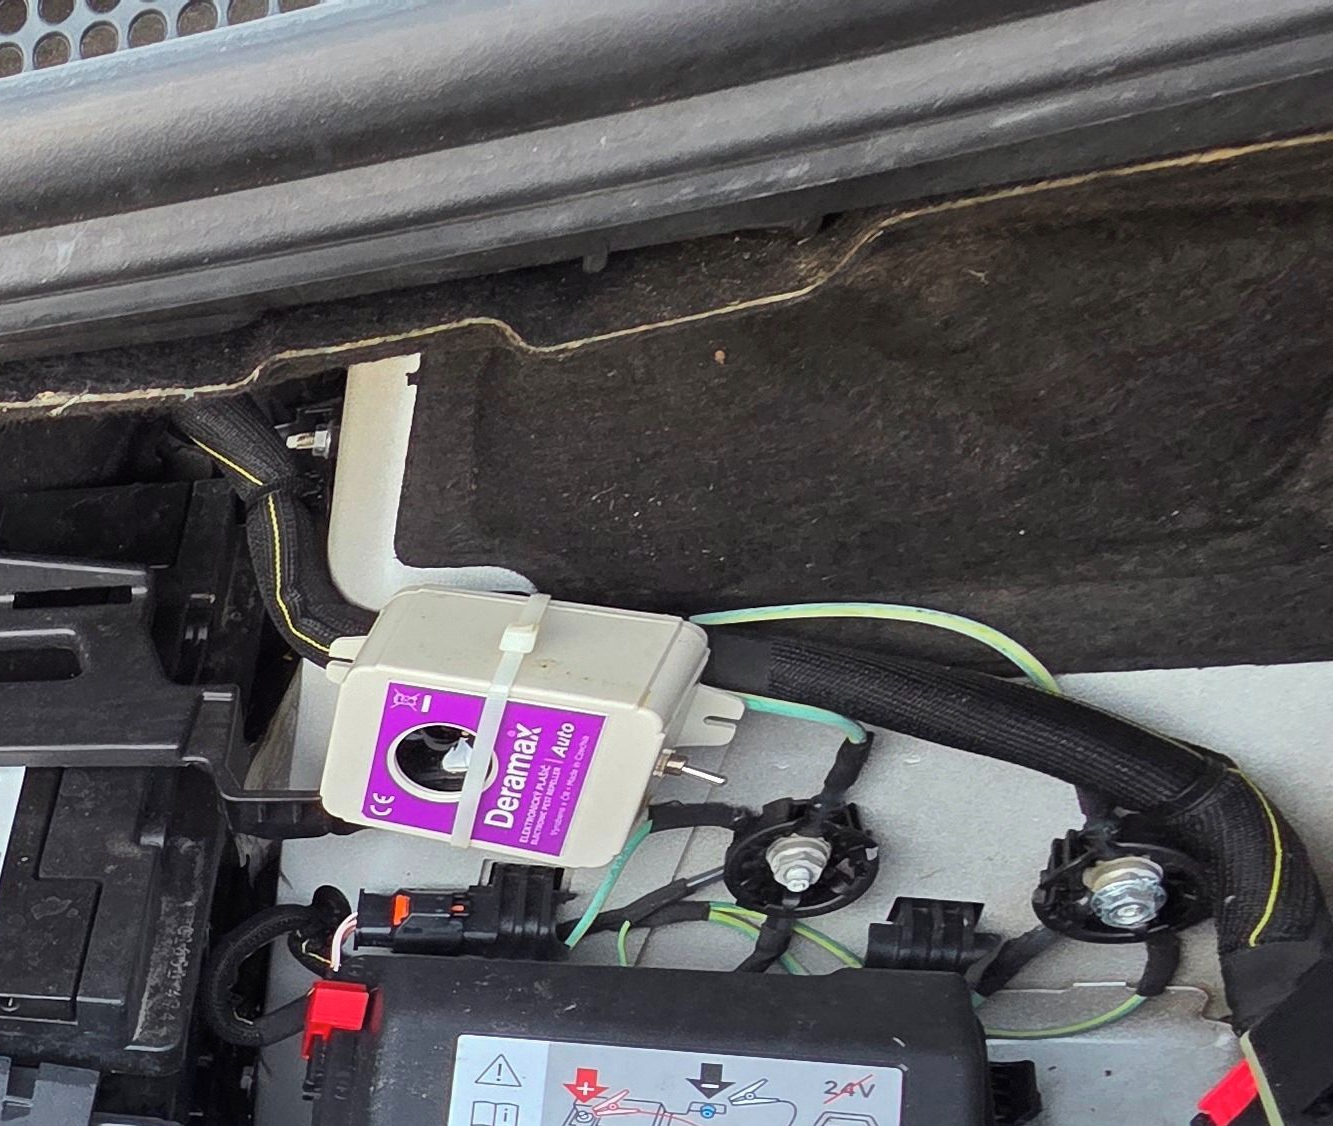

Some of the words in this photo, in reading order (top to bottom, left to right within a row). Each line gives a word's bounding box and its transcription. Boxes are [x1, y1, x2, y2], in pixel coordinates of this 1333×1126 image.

[551, 722, 575, 758] Auto
[484, 722, 542, 829] Deramax
[369, 792, 396, 816] CE
